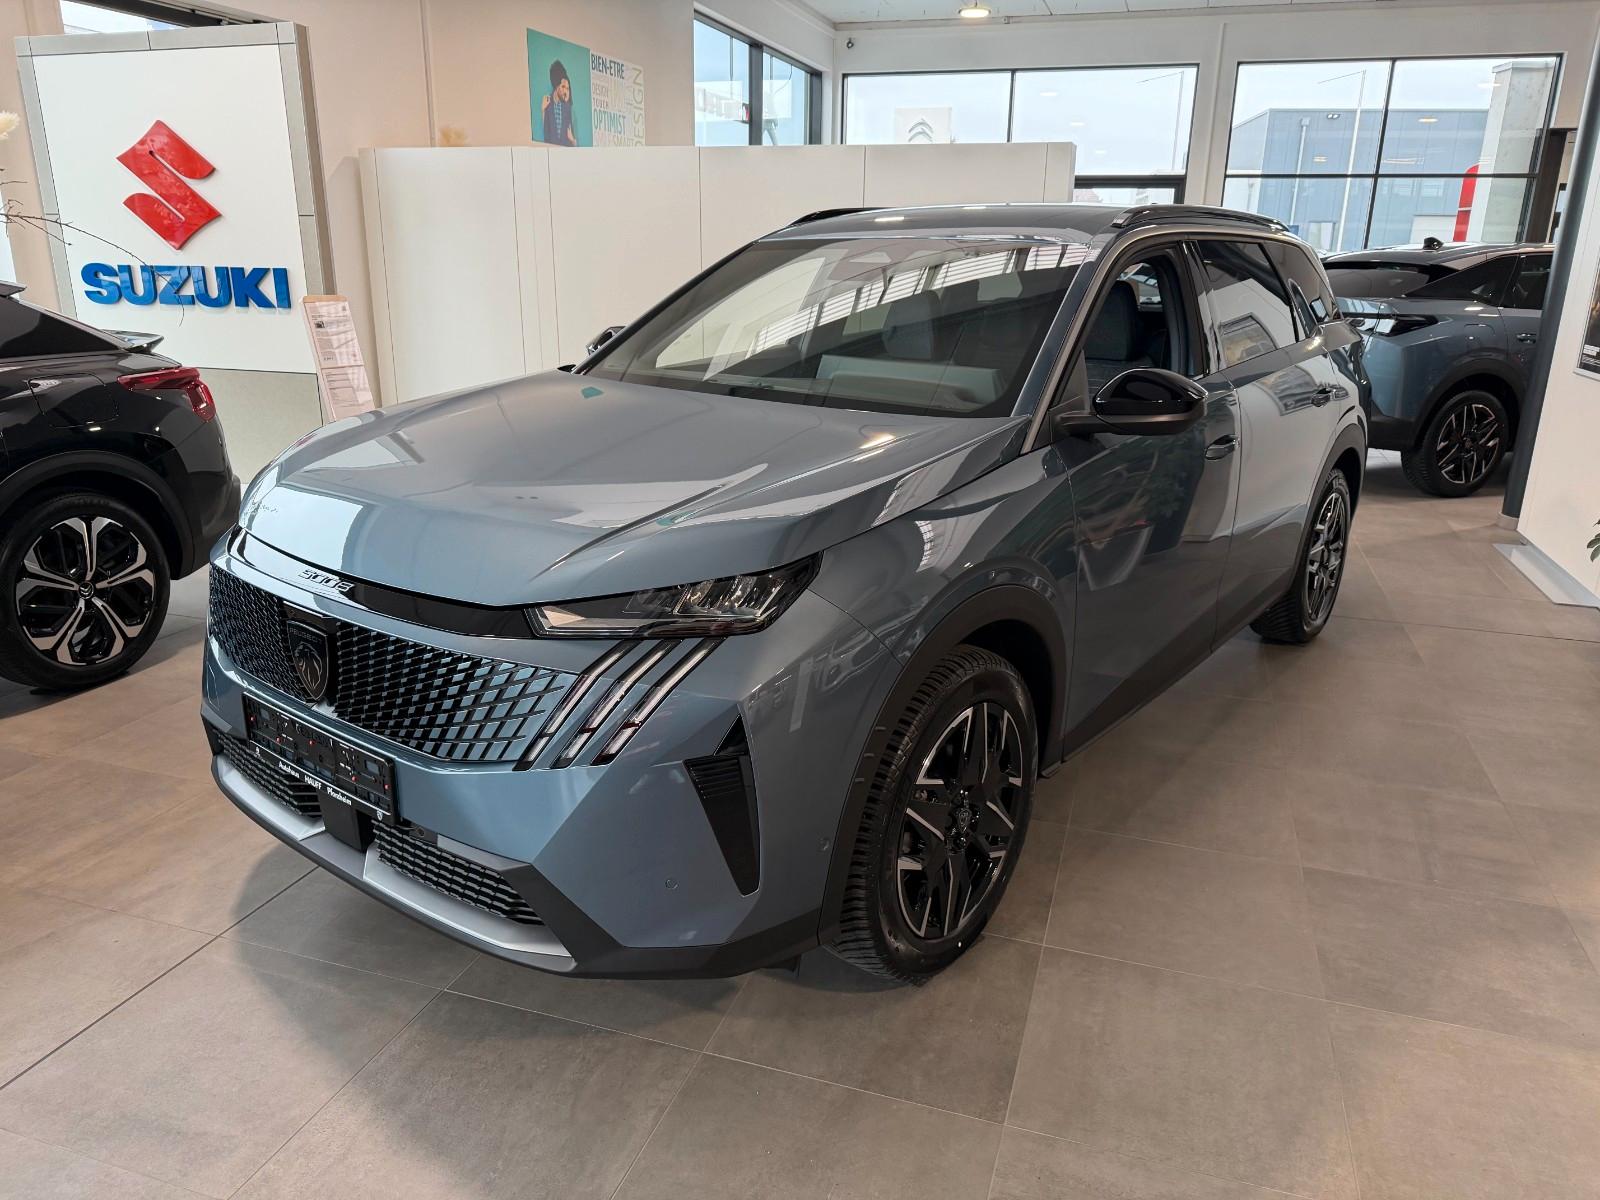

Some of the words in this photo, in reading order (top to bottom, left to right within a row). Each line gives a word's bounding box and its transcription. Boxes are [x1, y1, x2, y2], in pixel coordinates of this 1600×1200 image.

[591, 54, 625, 80] BIEN-ETRE
[593, 108, 626, 136] OPTIMIST
[80, 262, 291, 309] SUZUKI
[298, 569, 355, 592] 5008
[279, 761, 300, 779] Autohaus
[304, 776, 322, 790] HAUFF
[326, 786, 352, 806] Pforzheim
